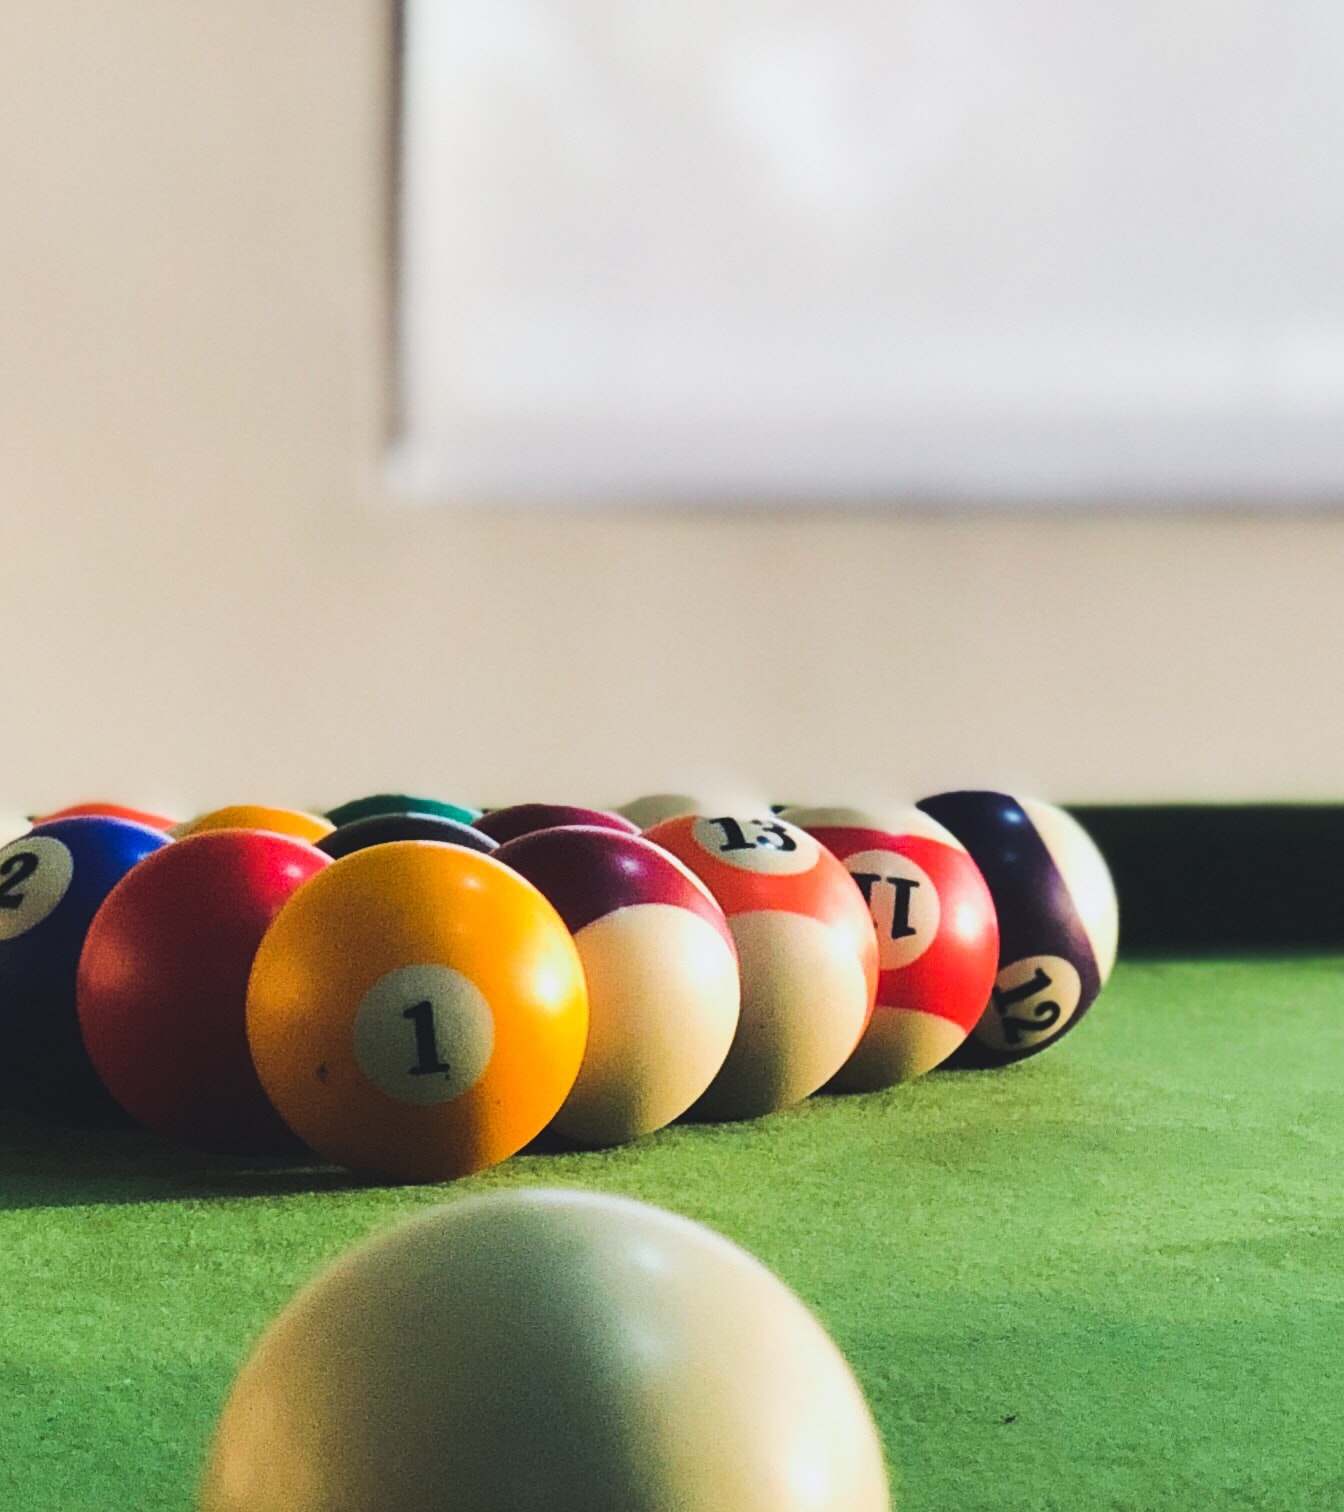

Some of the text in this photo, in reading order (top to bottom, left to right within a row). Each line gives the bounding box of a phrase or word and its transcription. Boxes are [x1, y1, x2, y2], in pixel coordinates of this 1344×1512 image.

[709, 816, 797, 852] 13
[403, 1000, 450, 1075] 1
[991, 967, 1060, 1044] 12
